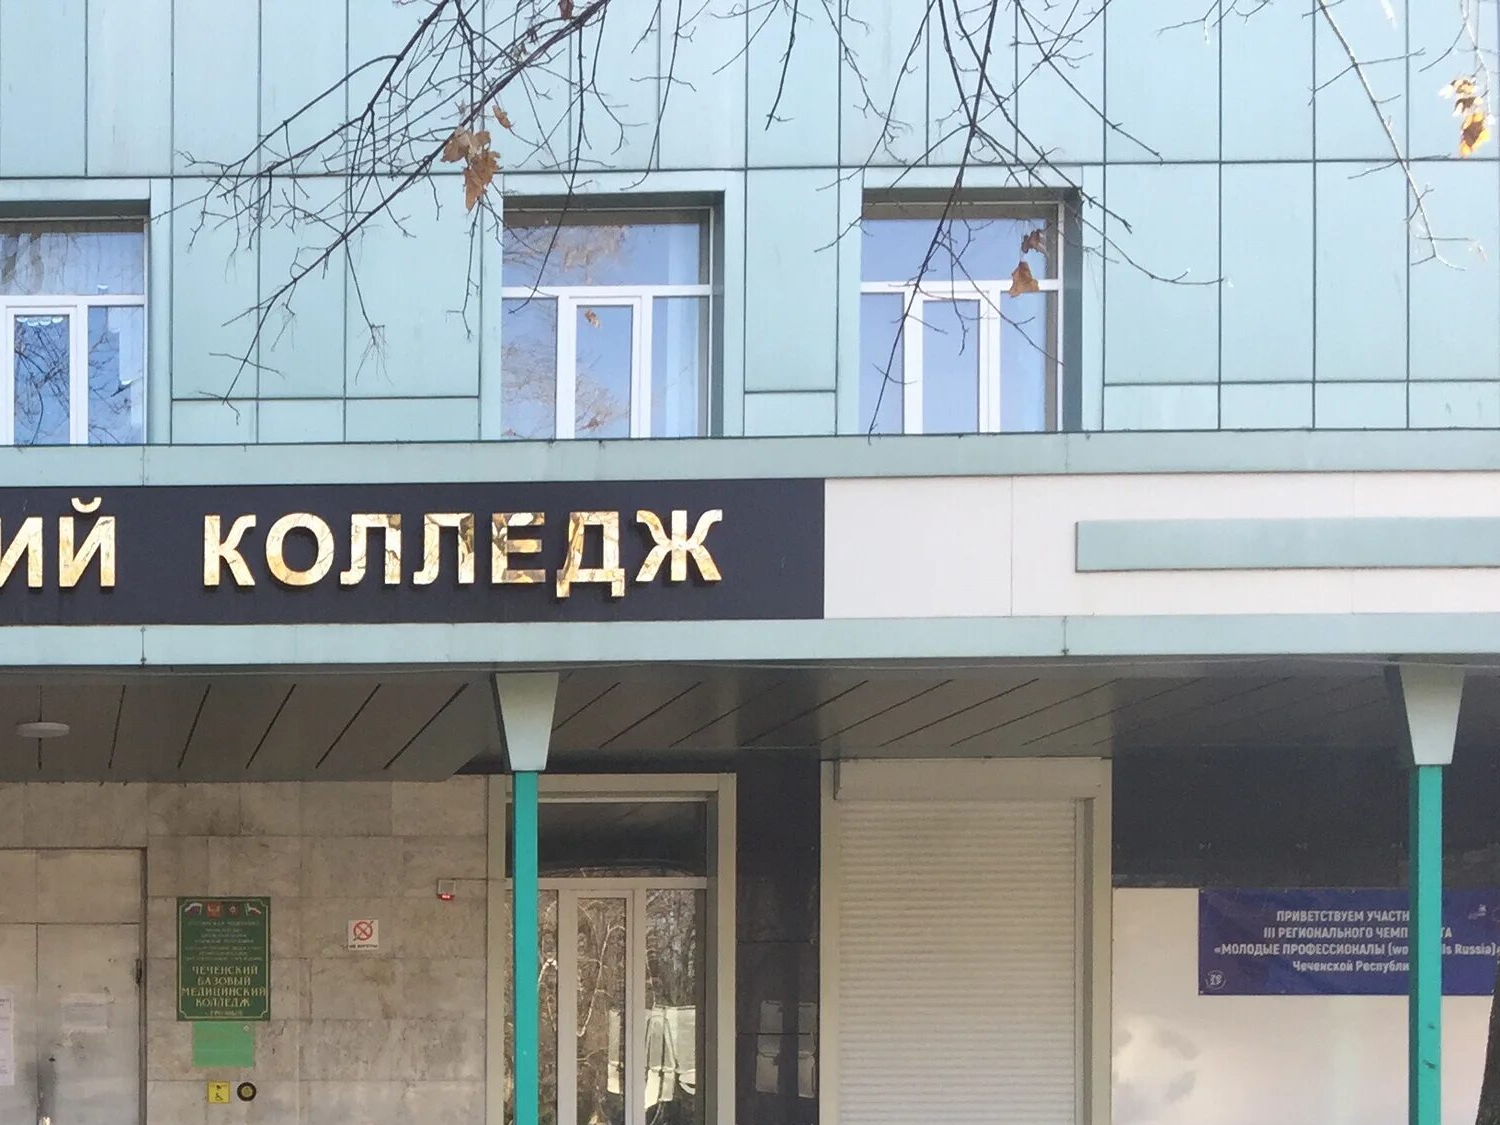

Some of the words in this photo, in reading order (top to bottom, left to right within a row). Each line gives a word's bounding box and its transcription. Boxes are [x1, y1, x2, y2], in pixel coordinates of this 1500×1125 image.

[203, 509, 723, 598] КОЛЛЕДЖ
[1276, 910, 1364, 922] ПРИВЕТСТВУЕМ
[1366, 910, 1411, 922] УЧАСТН
[1263, 927, 1275, 939] III
[1278, 927, 1373, 939] РЕГИОНАЛЬНОГО
[1214, 943, 1280, 957] «МОЛОДЫЕ
[1282, 943, 1385, 956] ПРОФЕССИОНАЛЫ
[191, 965, 258, 975] ЧЕЧЕНСКИЙ
[1292, 960, 1353, 972] Чеченской
[1355, 960, 1411, 974] Республи
[197, 976, 251, 986] БАЗОВЫЙ
[180, 986, 267, 997] МЕДИЦИНСКИЙ
[195, 997, 251, 1008] КОЛЛЕДЖ
